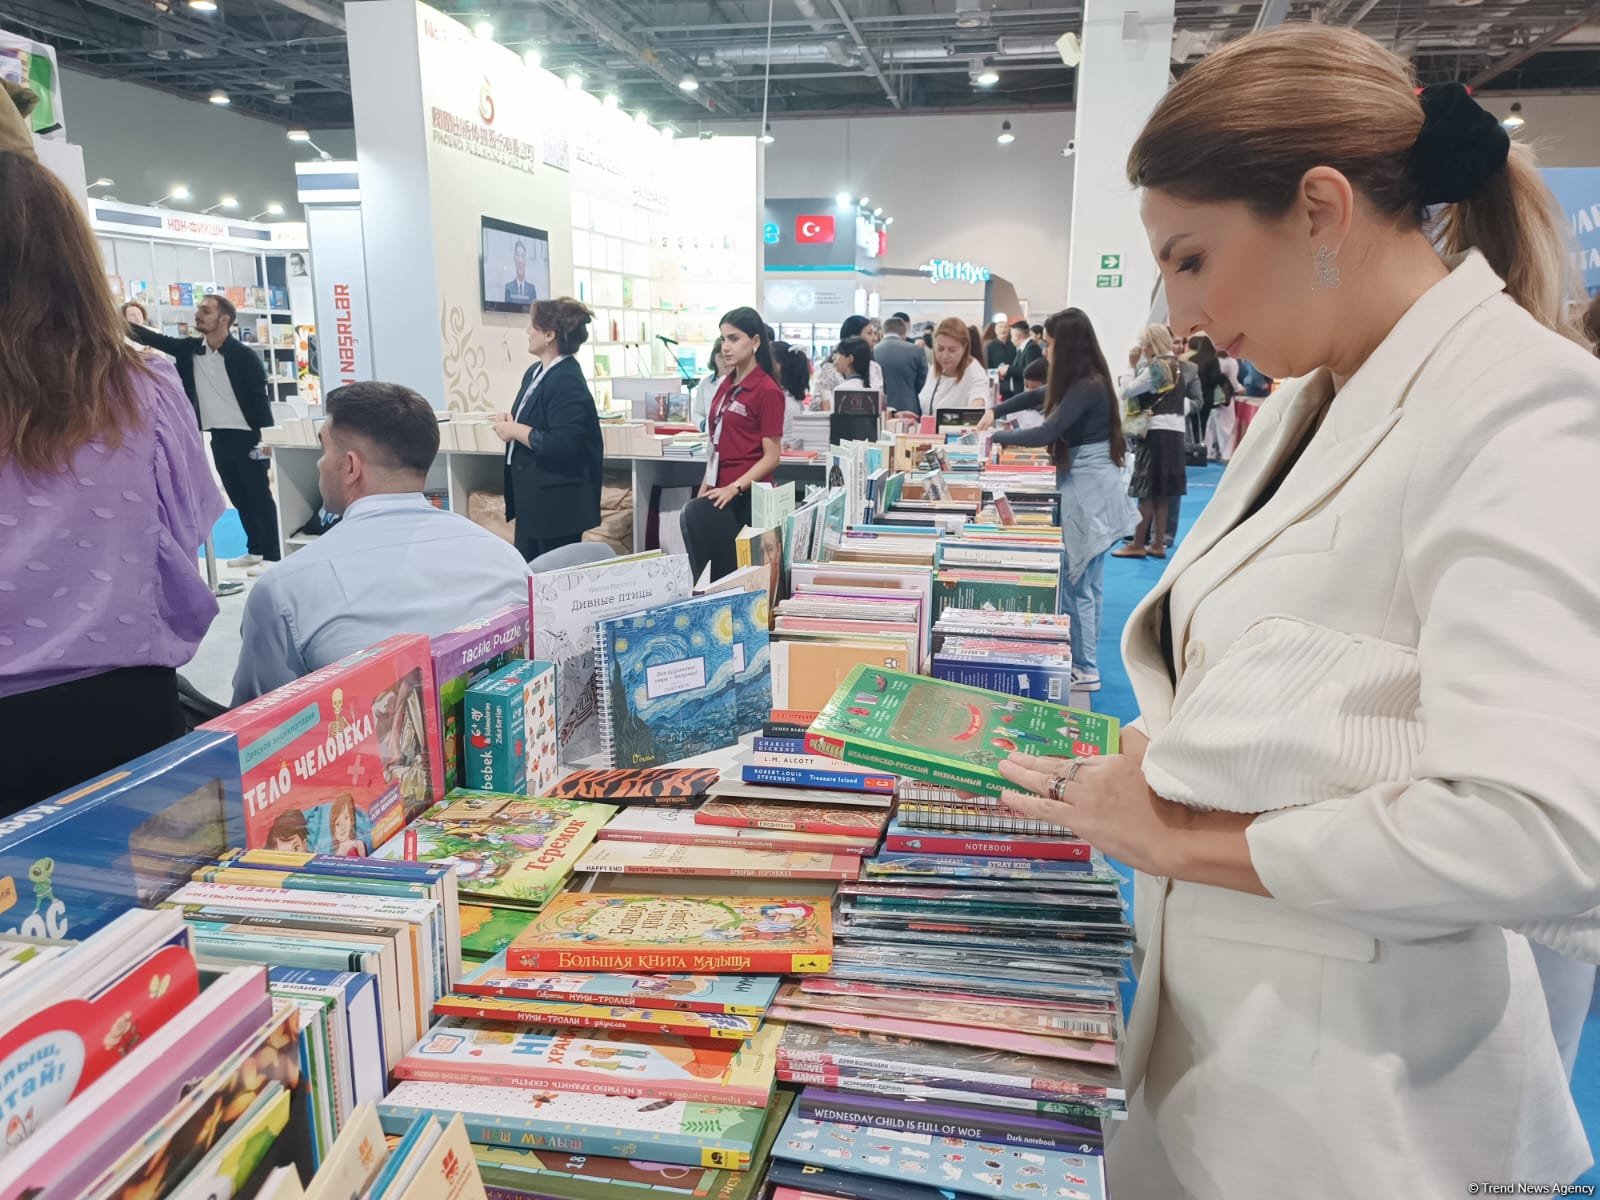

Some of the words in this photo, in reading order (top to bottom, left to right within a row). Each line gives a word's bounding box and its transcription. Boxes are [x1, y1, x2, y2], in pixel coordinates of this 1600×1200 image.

[571, 596, 615, 612] Дивные
[618, 589, 653, 603] птицы
[461, 640, 492, 666] Tactile
[493, 624, 521, 650] Puzzle
[243, 767, 292, 817] ТЕЛО
[294, 714, 374, 781] ЧЕЛОВЕКА
[783, 758, 815, 766] ALCOTT
[480, 750, 493, 791] bebek
[754, 768, 781, 776] ROBERT
[781, 769, 803, 777] LOUIS
[756, 774, 796, 783] STEVENSON
[809, 774, 836, 783] Treasure
[837, 775, 858, 785] Island
[523, 819, 587, 872] Теремок
[965, 842, 1012, 852] NOTEBOOK
[586, 864, 607, 872] HAPPY
[987, 861, 1012, 869] STRAY
[1012, 862, 1032, 870] KIDS
[568, 992, 636, 1006] МУМИ-ТРОЛЛЕЙ
[517, 1012, 580, 1025] МУМИ-ТРОЛЛИ
[788, 1061, 825, 1073] MARVEL
[791, 1072, 825, 1084] MARVEL
[551, 1081, 592, 1092] ХРАНИТЬ
[594, 1085, 620, 1094] УМЕЮ
[623, 1087, 635, 1095] НЕ
[712, 1095, 742, 1105] Ирина
[814, 1107, 874, 1126] WEDNESDAY
[874, 1115, 905, 1129] CHILD
[906, 1118, 915, 1130] IS
[917, 1120, 940, 1134] FULL
[942, 1122, 957, 1135] OF
[957, 1125, 982, 1139] WOE
[1006, 1133, 1026, 1143] Dark
[1027, 1135, 1056, 1148] notebook
[565, 1154, 587, 1169] 18
